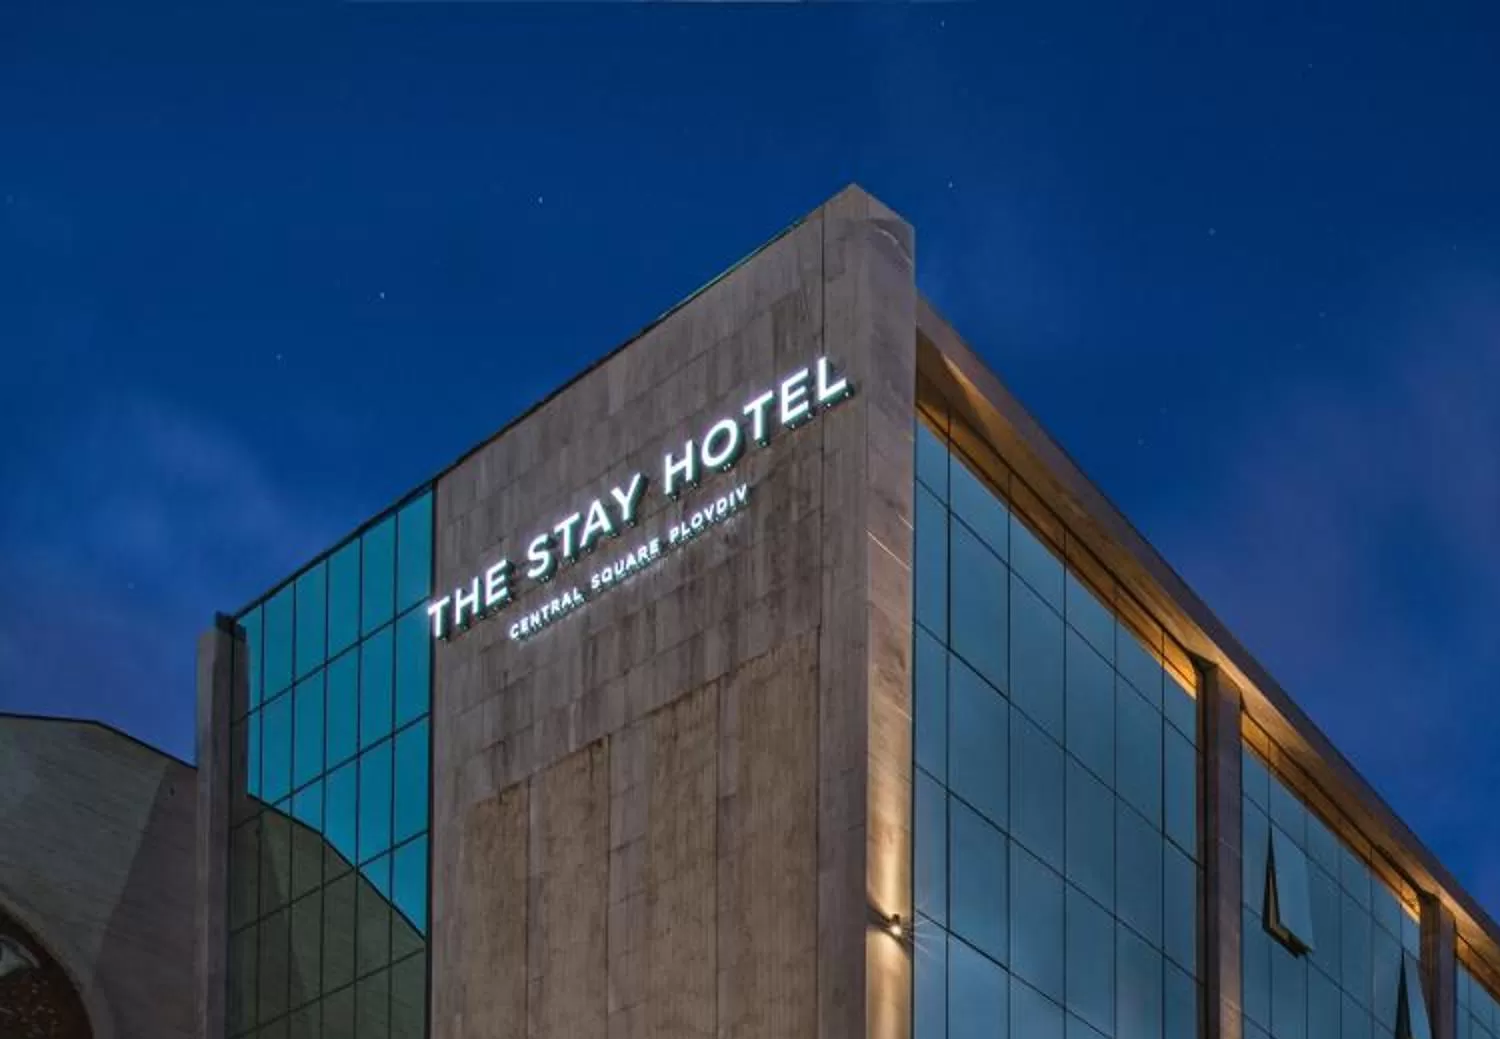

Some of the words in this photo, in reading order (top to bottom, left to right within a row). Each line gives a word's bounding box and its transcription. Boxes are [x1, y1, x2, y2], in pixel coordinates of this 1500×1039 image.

[427, 557, 510, 640] THE
[526, 471, 642, 580] STAY
[663, 355, 849, 497] HOTEL
[509, 586, 585, 641] CENTRAL
[590, 536, 662, 591] SQUARE
[667, 482, 749, 544] PLOVDIV
